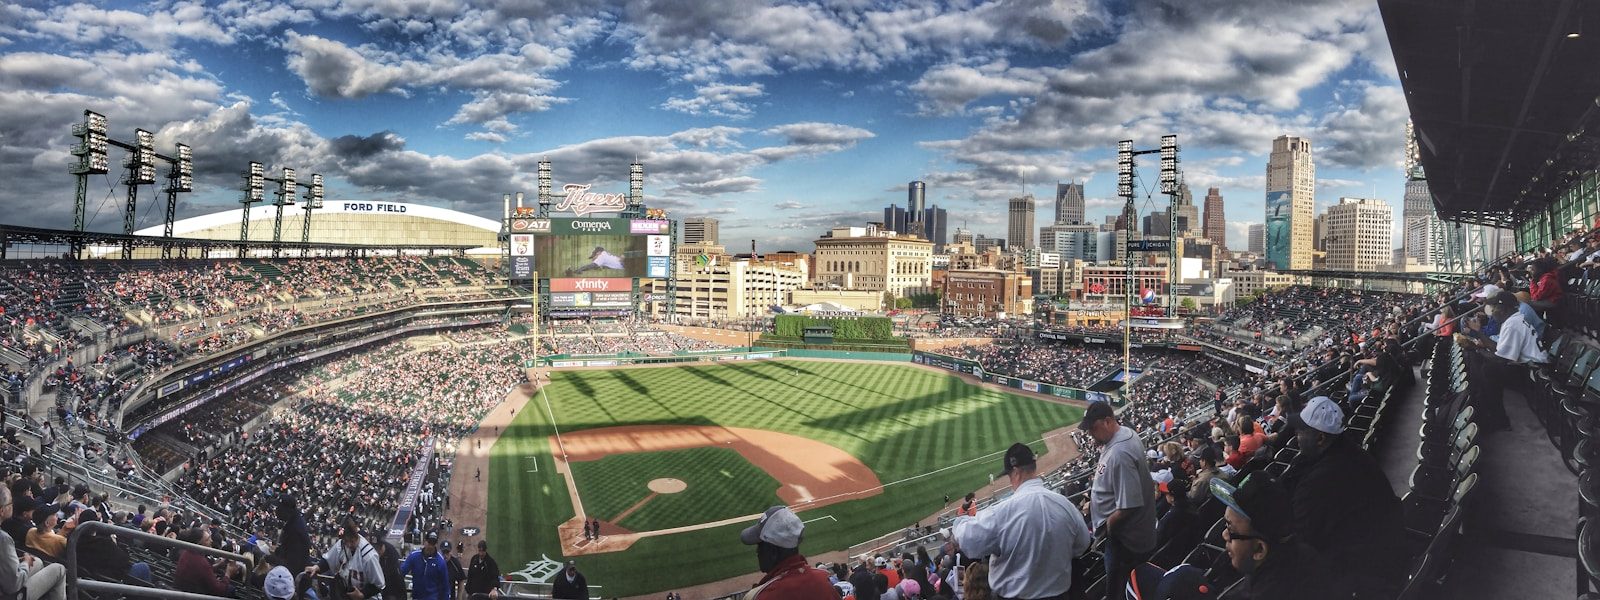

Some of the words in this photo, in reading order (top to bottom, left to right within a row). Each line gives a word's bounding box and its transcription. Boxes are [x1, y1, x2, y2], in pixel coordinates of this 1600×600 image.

[556, 183, 626, 217] Tigers
[344, 203, 373, 211] FORD
[377, 204, 407, 212] FIELD
[528, 220, 551, 229] ATI
[575, 279, 609, 291] xfinity
[161, 408, 181, 423] DETROIT
[185, 399, 199, 411] TEXAS
